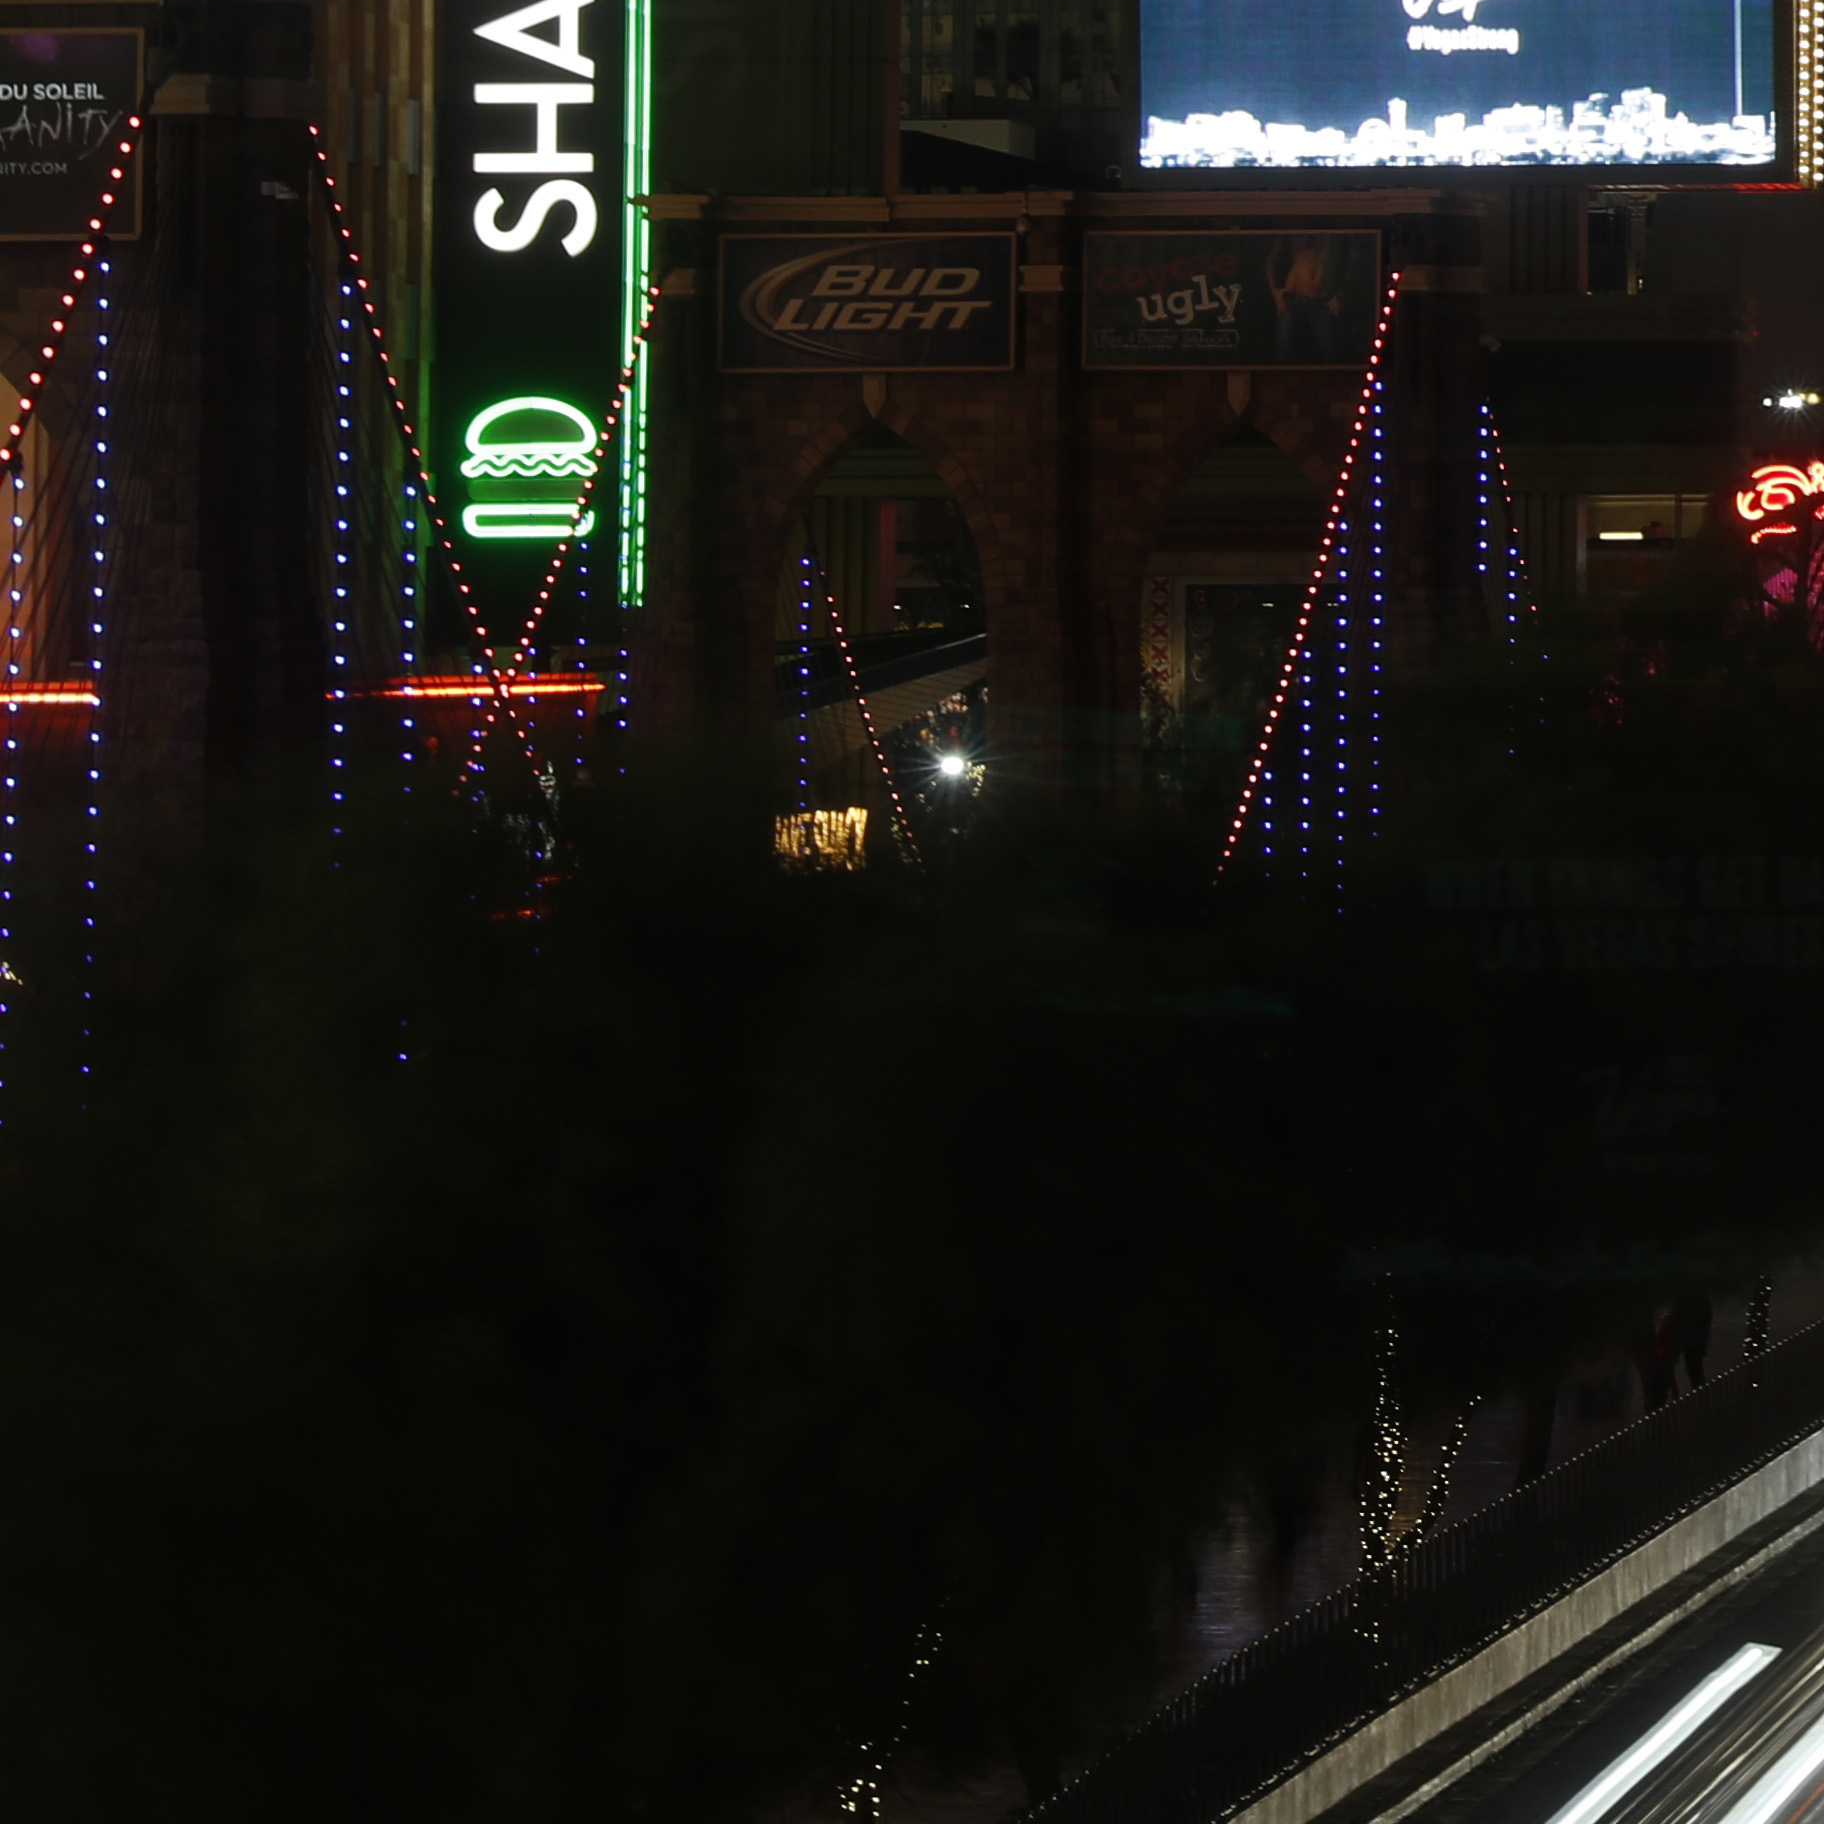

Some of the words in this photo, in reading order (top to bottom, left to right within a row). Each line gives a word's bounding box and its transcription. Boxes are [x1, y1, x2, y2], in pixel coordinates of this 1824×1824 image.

[33, 82, 105, 101] SOLEIL
[0, 101, 124, 161] ANITY
[811, 265, 982, 298] BUD
[772, 300, 992, 331] LIGHT
[1136, 274, 1243, 325] ugly
